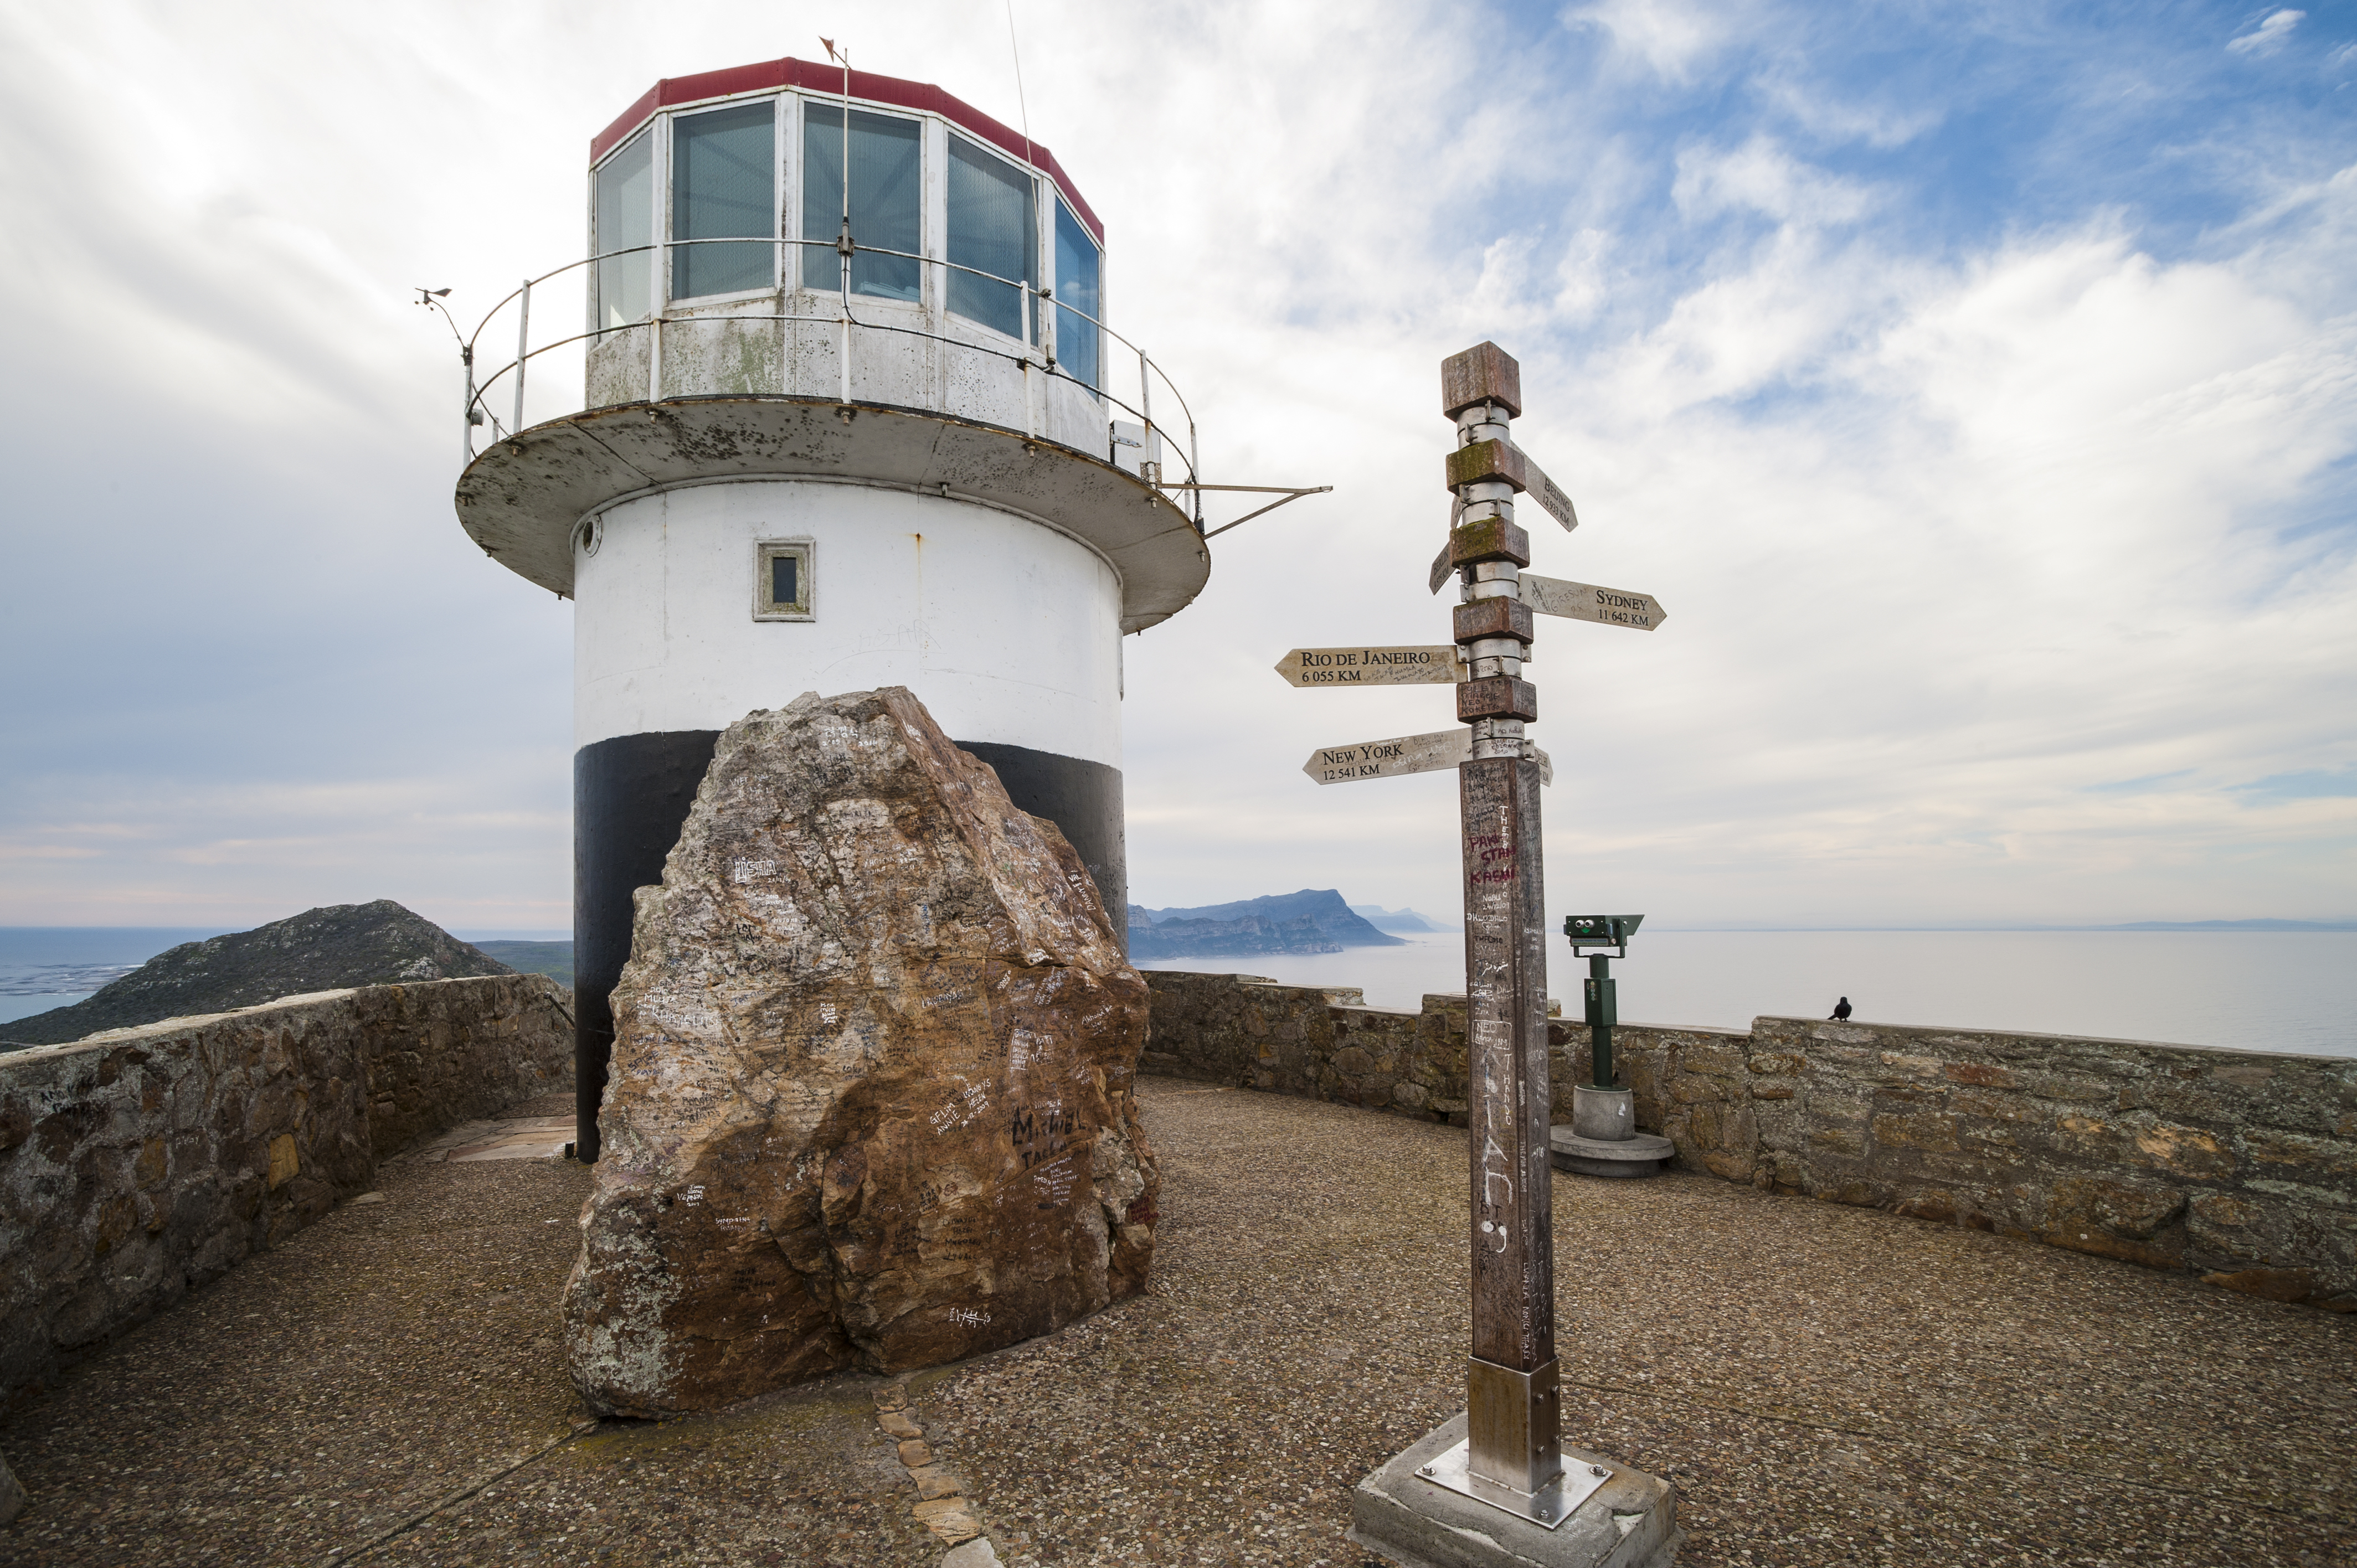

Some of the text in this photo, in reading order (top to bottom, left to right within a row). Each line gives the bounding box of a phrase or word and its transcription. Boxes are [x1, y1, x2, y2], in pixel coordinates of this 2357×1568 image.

[1544, 477, 1570, 512] BEIJING
[1543, 494, 1569, 526] 12 933 KM
[1433, 548, 1449, 576] BERLIN
[1596, 590, 1648, 611] SYDNEY
[1599, 609, 1649, 627] 11 642 KM
[1301, 651, 1430, 667] RIO DE JANEIRO
[1301, 670, 1361, 682] 6 055 KM
[1322, 744, 1404, 765] NEW YORK
[1534, 749, 1548, 768] DELHI
[1324, 764, 1380, 781] 12 541 KM
[937, 1110, 961, 1136] ANNIE
